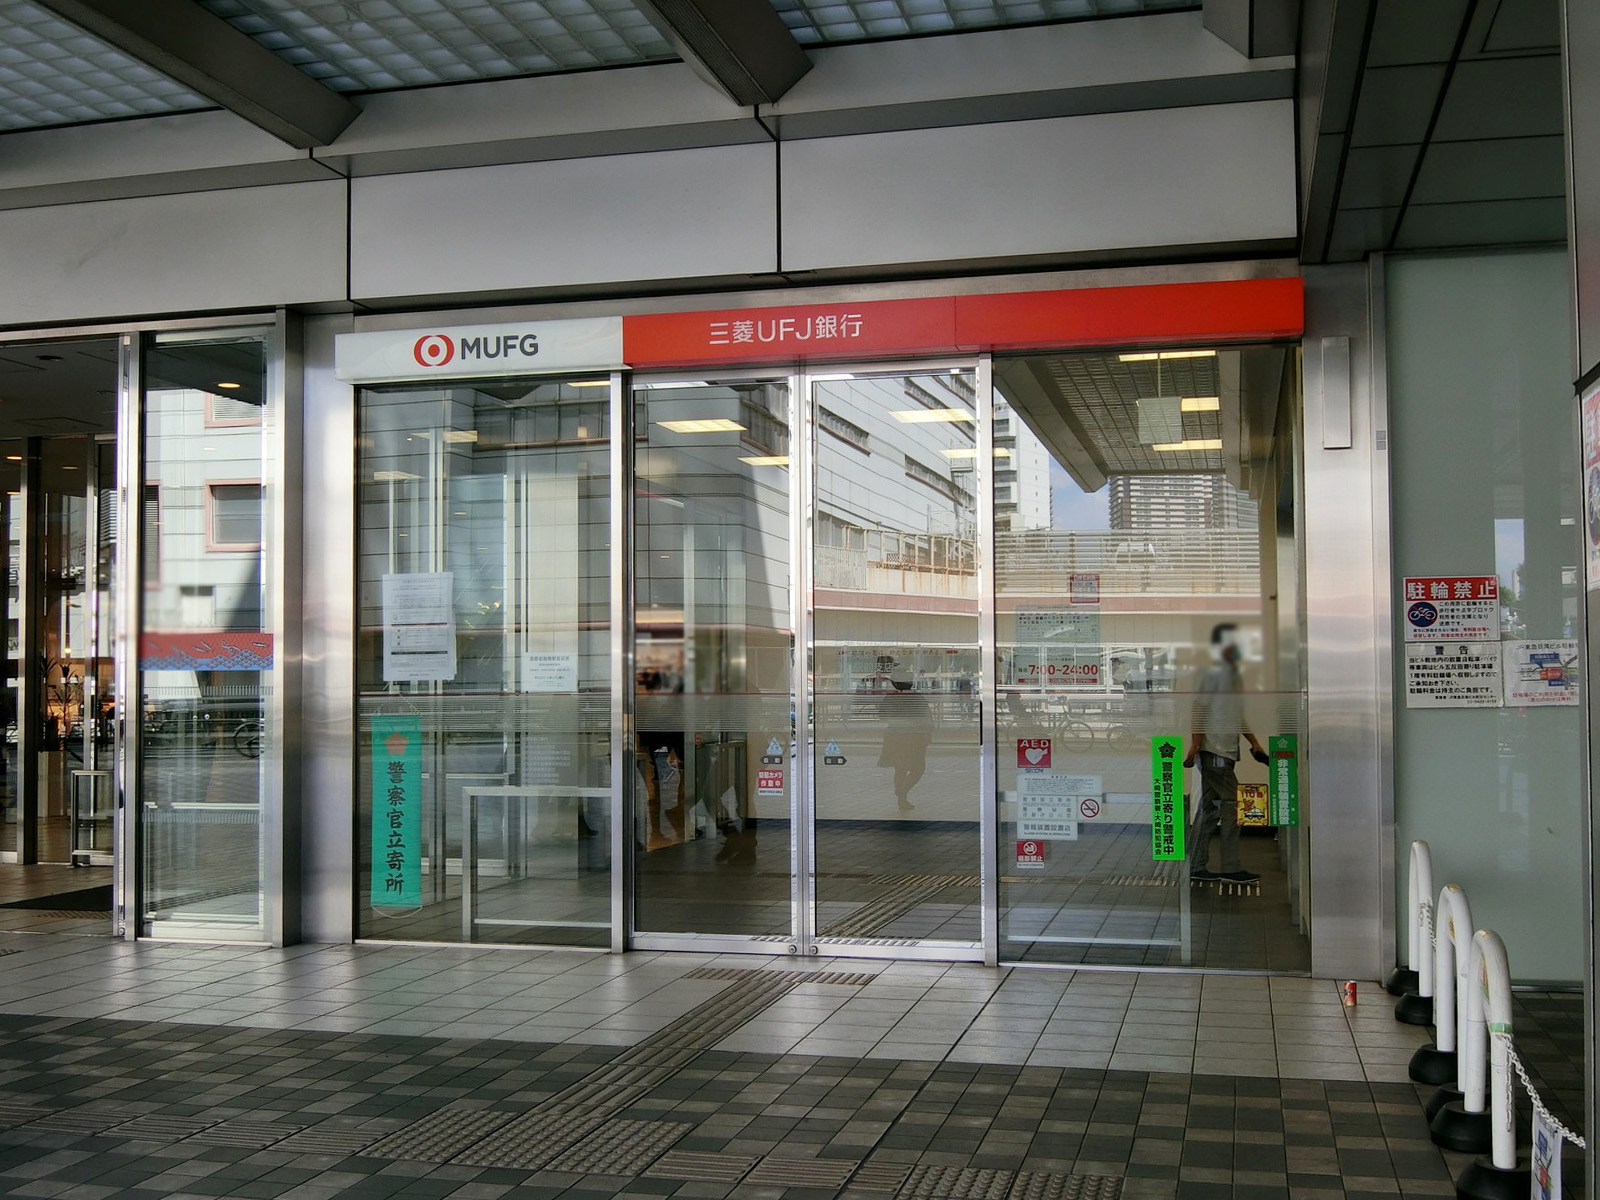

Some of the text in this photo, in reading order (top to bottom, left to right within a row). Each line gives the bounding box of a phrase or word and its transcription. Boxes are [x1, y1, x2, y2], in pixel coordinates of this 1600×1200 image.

[709, 314, 862, 345] 三菱UFJ銀行
[461, 334, 538, 361] MUFG
[1407, 580, 1496, 599] 駐輪禁止
[1020, 739, 1049, 748] AED
[1162, 762, 1174, 855] 警察官立寄り警戒中
[385, 761, 407, 896] 警察官立寄所
